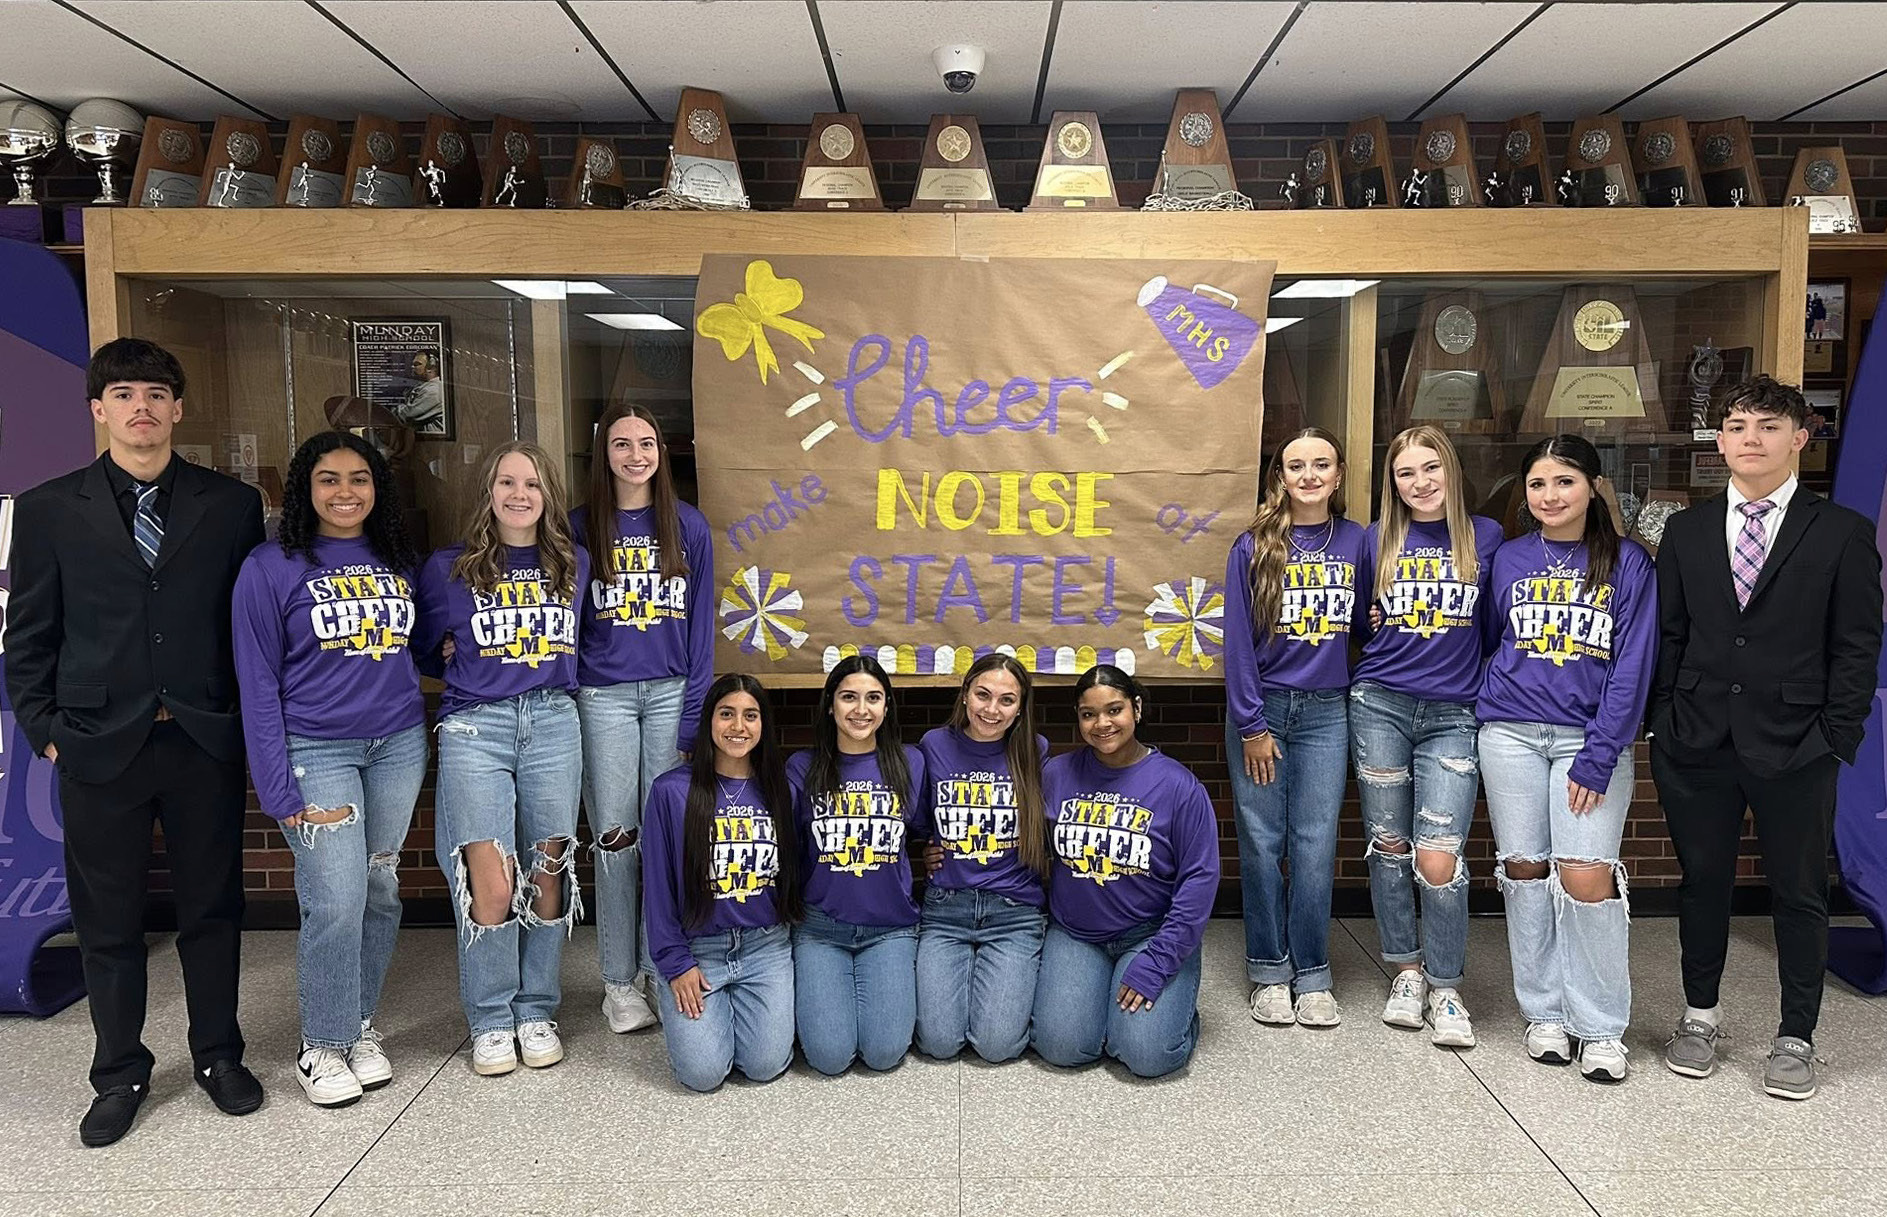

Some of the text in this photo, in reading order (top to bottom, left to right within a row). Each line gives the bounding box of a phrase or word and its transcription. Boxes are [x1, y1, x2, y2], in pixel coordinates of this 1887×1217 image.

[1450, 185, 1463, 198] 90
[1604, 184, 1618, 198] 90
[1670, 186, 1684, 200] 91
[1730, 187, 1744, 201] 91
[1832, 220, 1846, 232] 95
[360, 326, 436, 335] MUNDAY
[1164, 303, 1231, 363] MHS
[833, 333, 1093, 443] Cheer
[725, 468, 1224, 554] make NOISE at
[623, 536, 650, 546] 2026
[1300, 552, 1325, 563] 2026
[1415, 548, 1443, 557] 2026
[343, 565, 373, 576] 2026
[512, 569, 541, 580] 2026
[1283, 562, 1355, 590] TATE
[1550, 568, 1580, 578] 2026
[306, 574, 413, 603] STATE
[840, 554, 1120, 629] STATE!
[629, 601, 647, 617] M
[1280, 589, 1355, 623] HEER
[1304, 617, 1321, 633] M
[1417, 610, 1435, 626] M
[470, 607, 576, 647] CHEER
[1509, 604, 1613, 650] CHEER
[365, 628, 384, 647] M
[1547, 634, 1565, 651] M
[520, 637, 540, 655] M
[1586, 648, 1610, 660] SCHOOL
[969, 771, 995, 782] 2026
[846, 781, 873, 791] 2026
[1094, 792, 1120, 803] 2026
[727, 806, 754, 816] 2026
[1057, 798, 1154, 835] STATE
[934, 807, 1019, 841] CHEE
[811, 818, 906, 854] CHEER
[971, 834, 989, 851] M
[848, 846, 865, 863] M
[1053, 824, 1152, 869] CHEER
[1087, 855, 1104, 873] M
[730, 872, 750, 889] M
